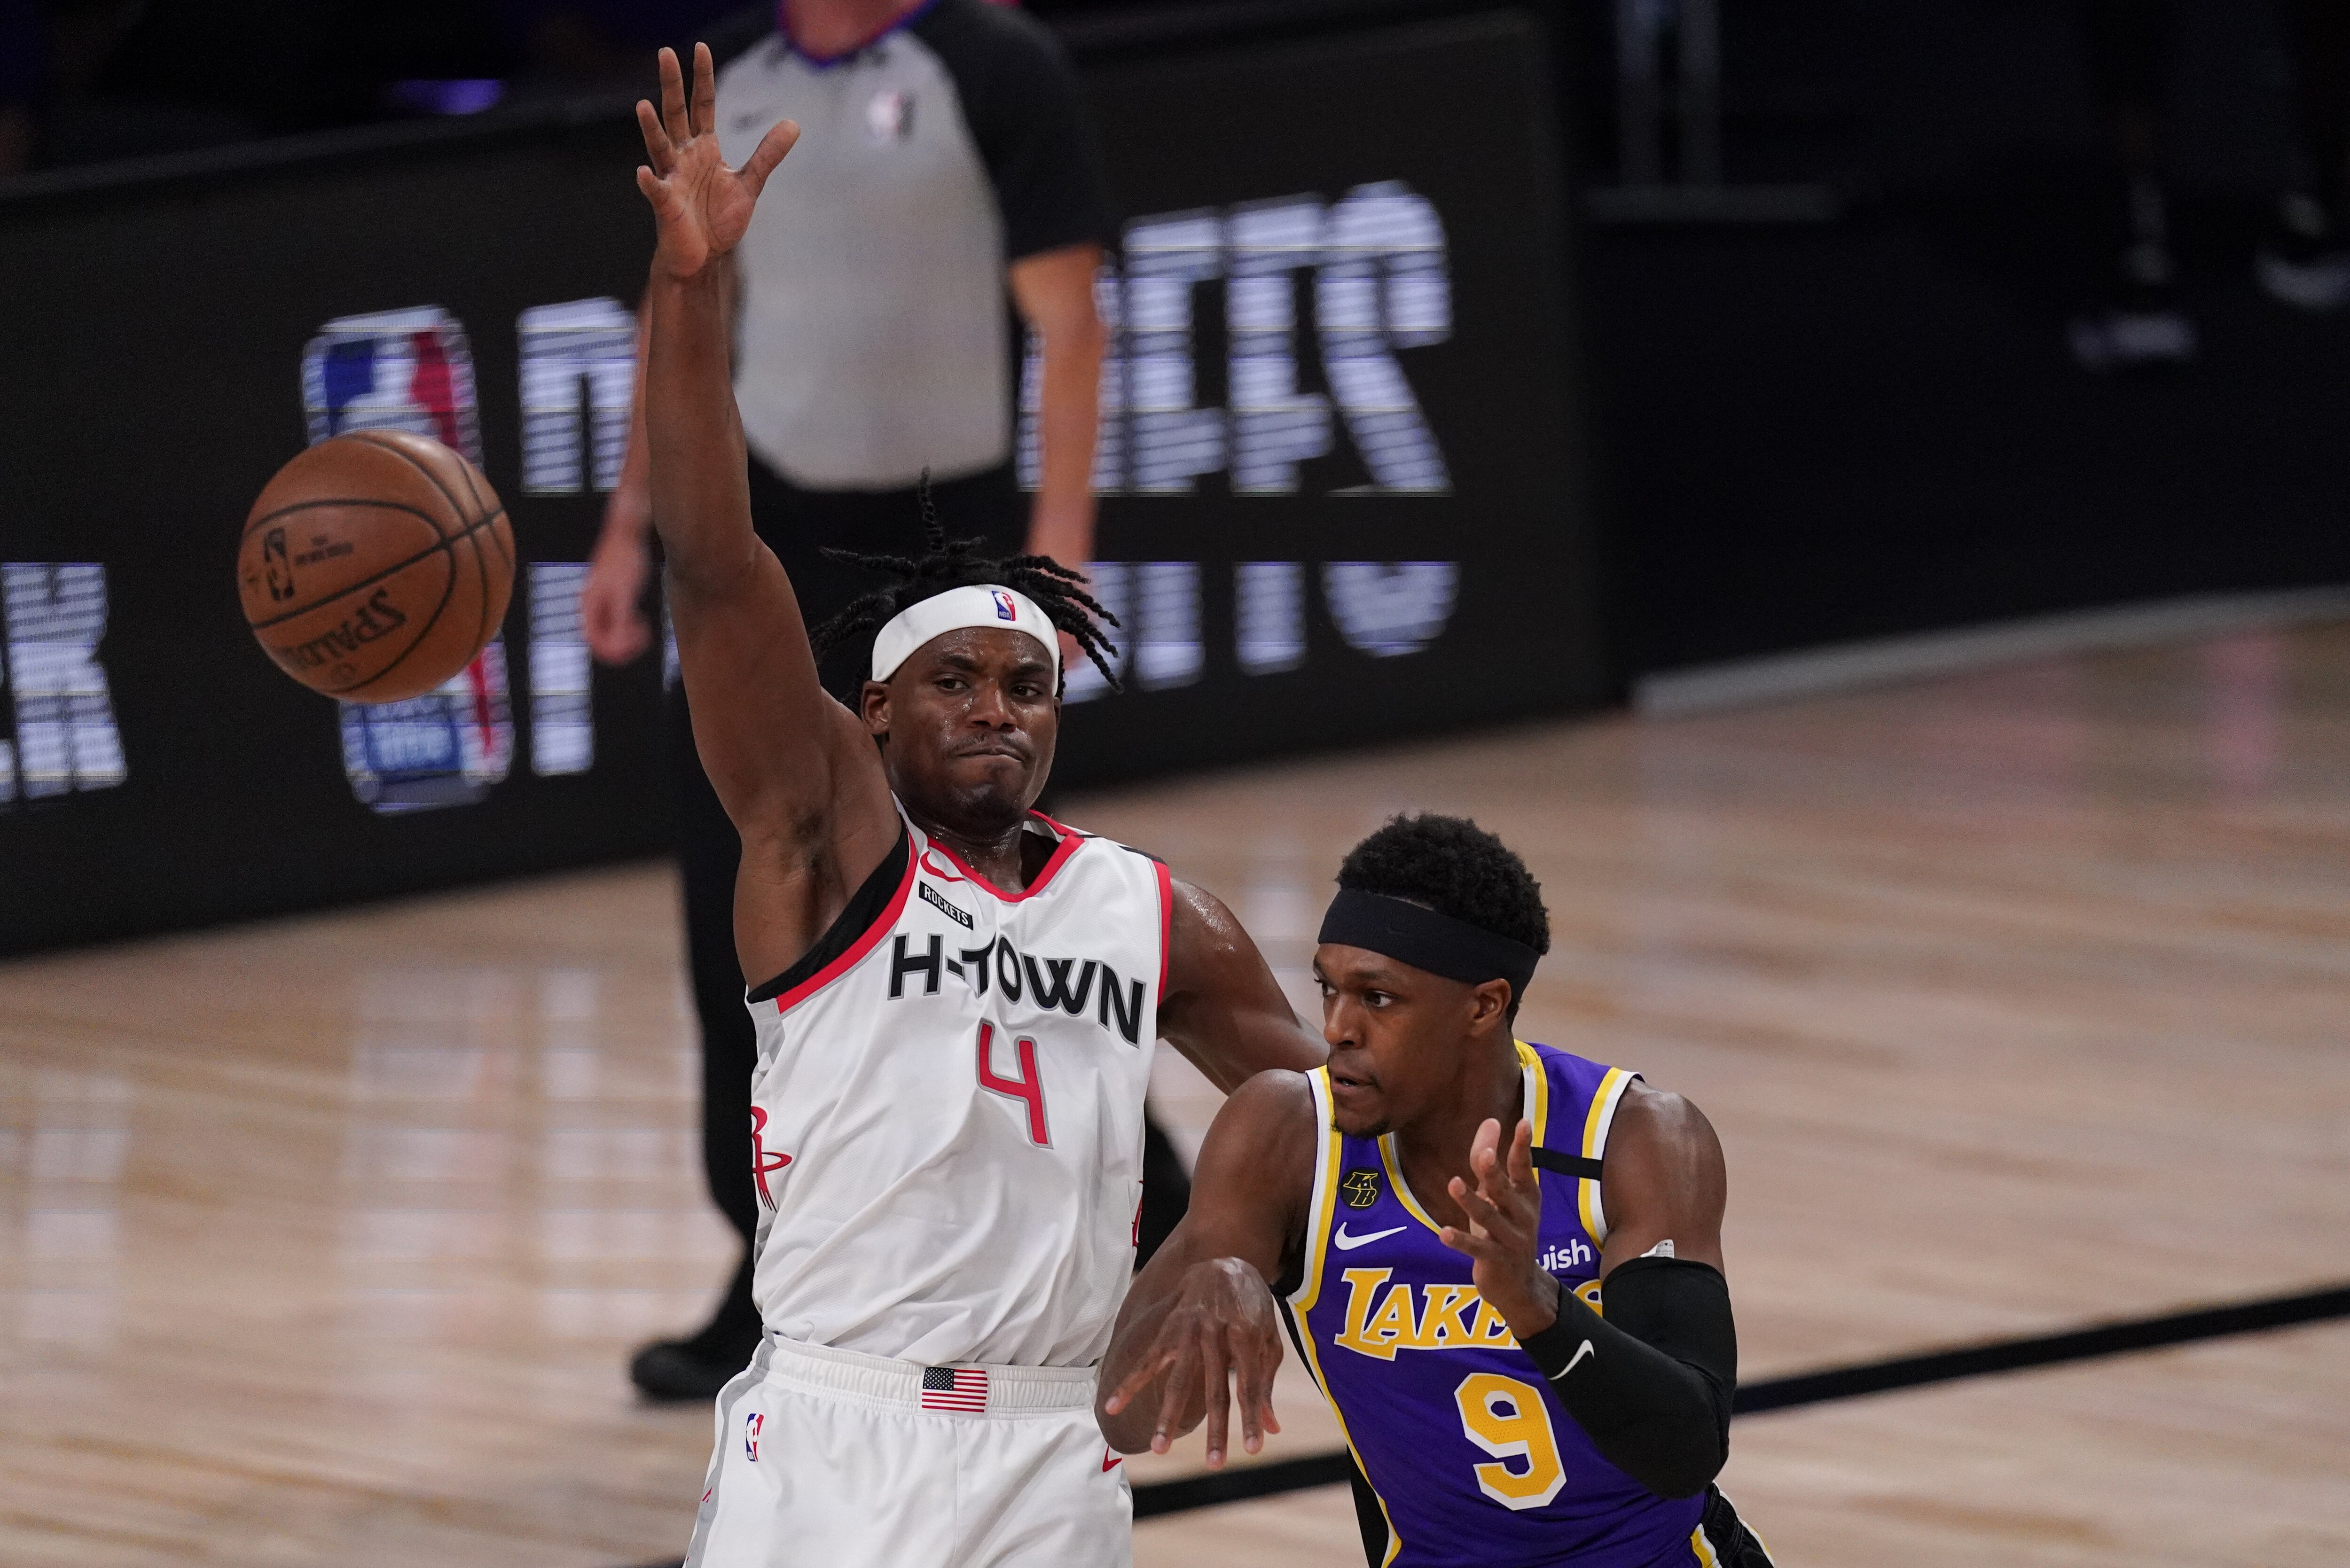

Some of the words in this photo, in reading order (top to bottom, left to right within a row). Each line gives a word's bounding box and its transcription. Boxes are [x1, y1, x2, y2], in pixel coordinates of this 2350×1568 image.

[275, 588, 407, 671] SPALD
[924, 885, 969, 925] ROCKETS
[887, 932, 1147, 1048] H-TOWN
[976, 1018, 1054, 1149] 4
[1334, 1267, 1603, 1361] LAKE
[1454, 1372, 1567, 1511] 9
